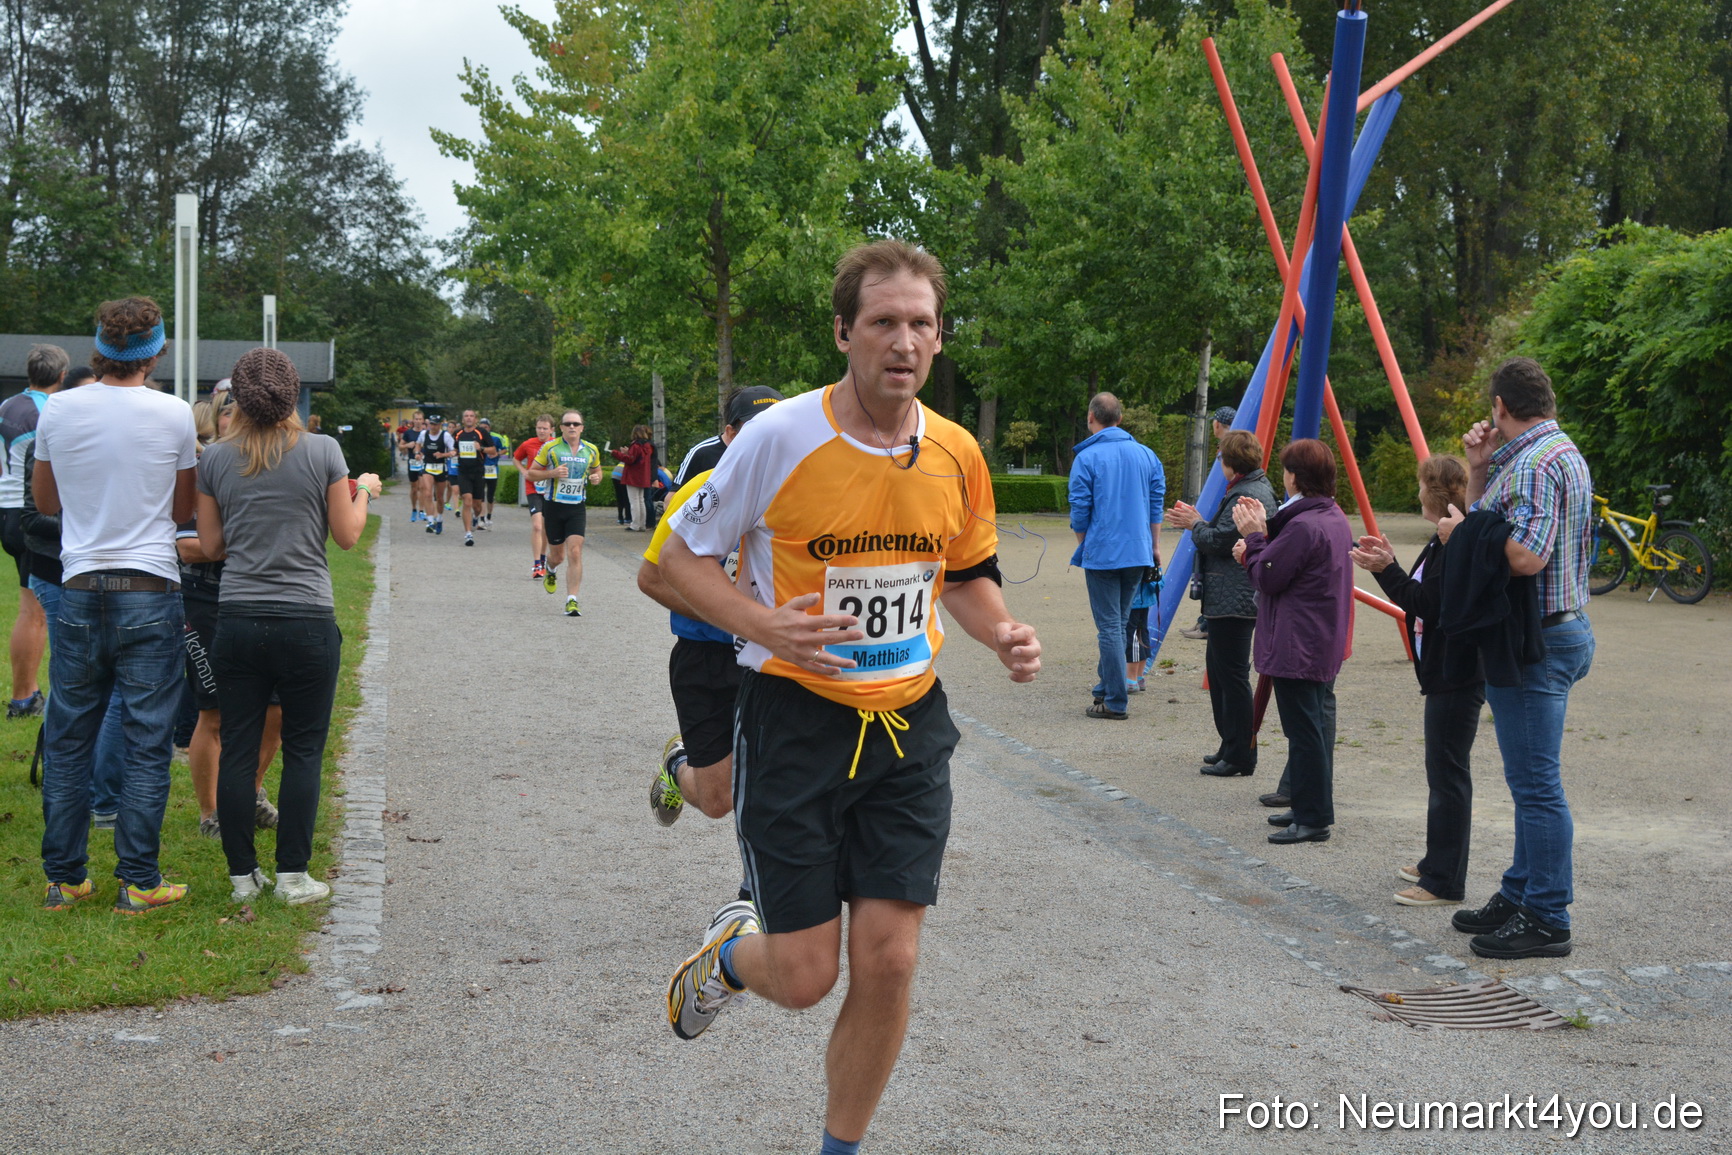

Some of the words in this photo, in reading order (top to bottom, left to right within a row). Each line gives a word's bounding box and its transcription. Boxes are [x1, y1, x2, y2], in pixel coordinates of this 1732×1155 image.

[560, 456, 587, 464] BOCK
[559, 483, 581, 495] 2874
[807, 530, 935, 561] Continental
[828, 578, 871, 590] PARTL
[874, 574, 920, 589] Neumarkt
[838, 588, 924, 638] 2814
[852, 647, 910, 668] Matthias
